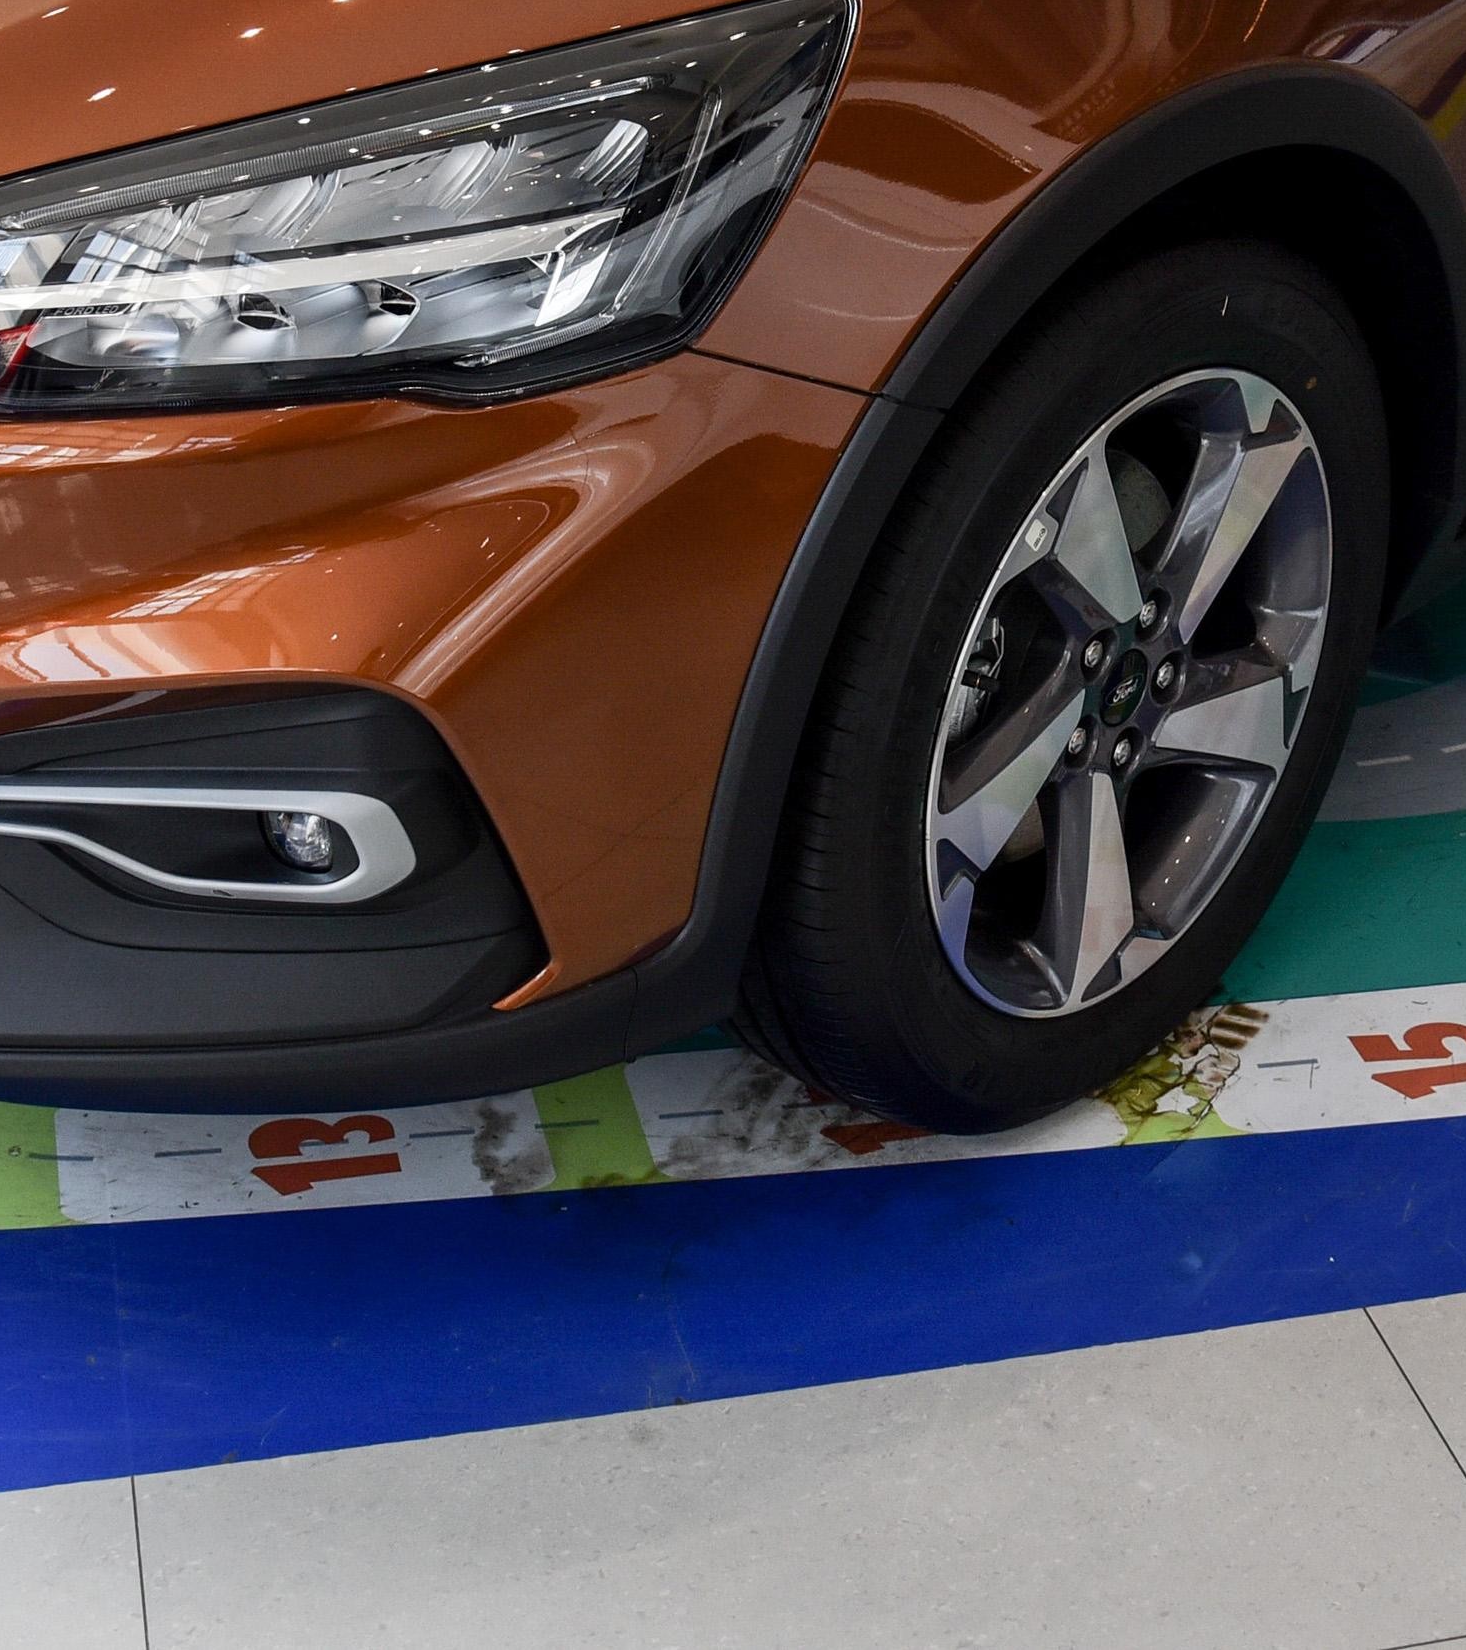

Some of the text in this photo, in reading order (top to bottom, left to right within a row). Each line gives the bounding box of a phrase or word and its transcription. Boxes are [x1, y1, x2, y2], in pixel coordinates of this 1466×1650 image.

[54, 305, 119, 316] FORD LED
[248, 1114, 401, 1196] 13
